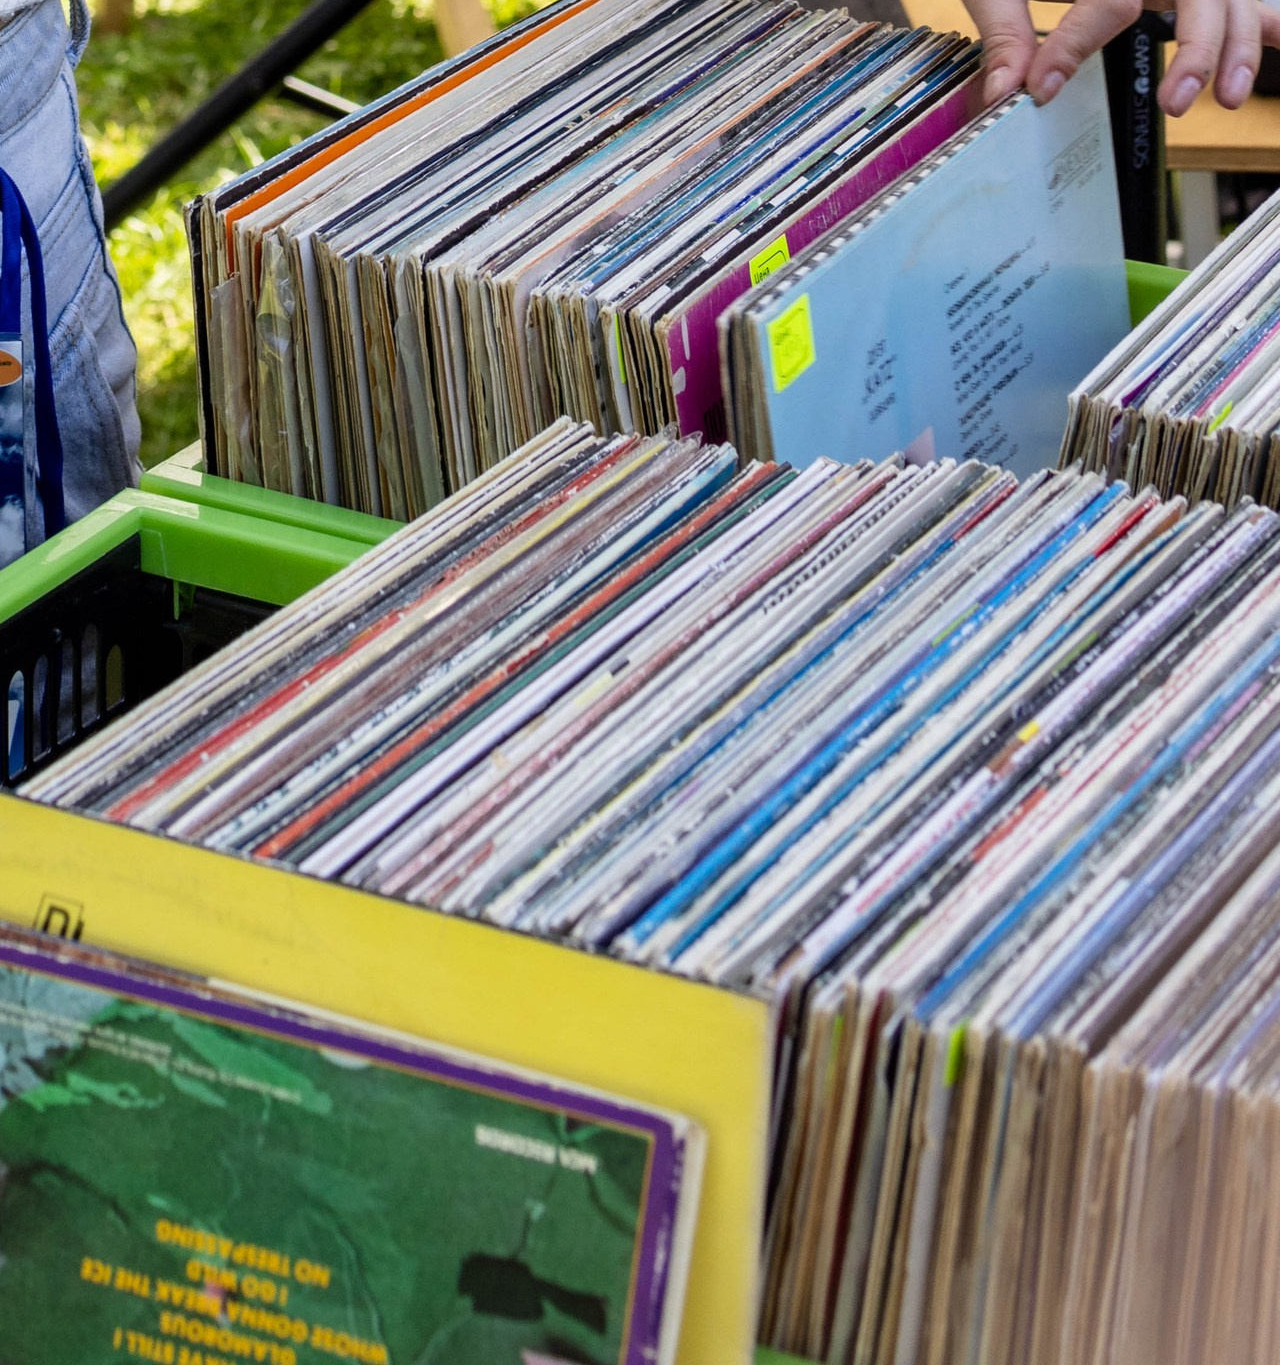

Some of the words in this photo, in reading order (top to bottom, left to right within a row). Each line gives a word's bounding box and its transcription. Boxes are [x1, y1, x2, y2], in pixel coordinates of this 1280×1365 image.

[155, 1219, 291, 1278] TRESPASSING
[80, 1257, 113, 1286] ICE
[113, 1267, 151, 1298] THE
[293, 1258, 331, 1288] NO
[240, 1275, 278, 1304] GO
[278, 1286, 289, 1306] I
[159, 1310, 297, 1365] GLAMOROUS
